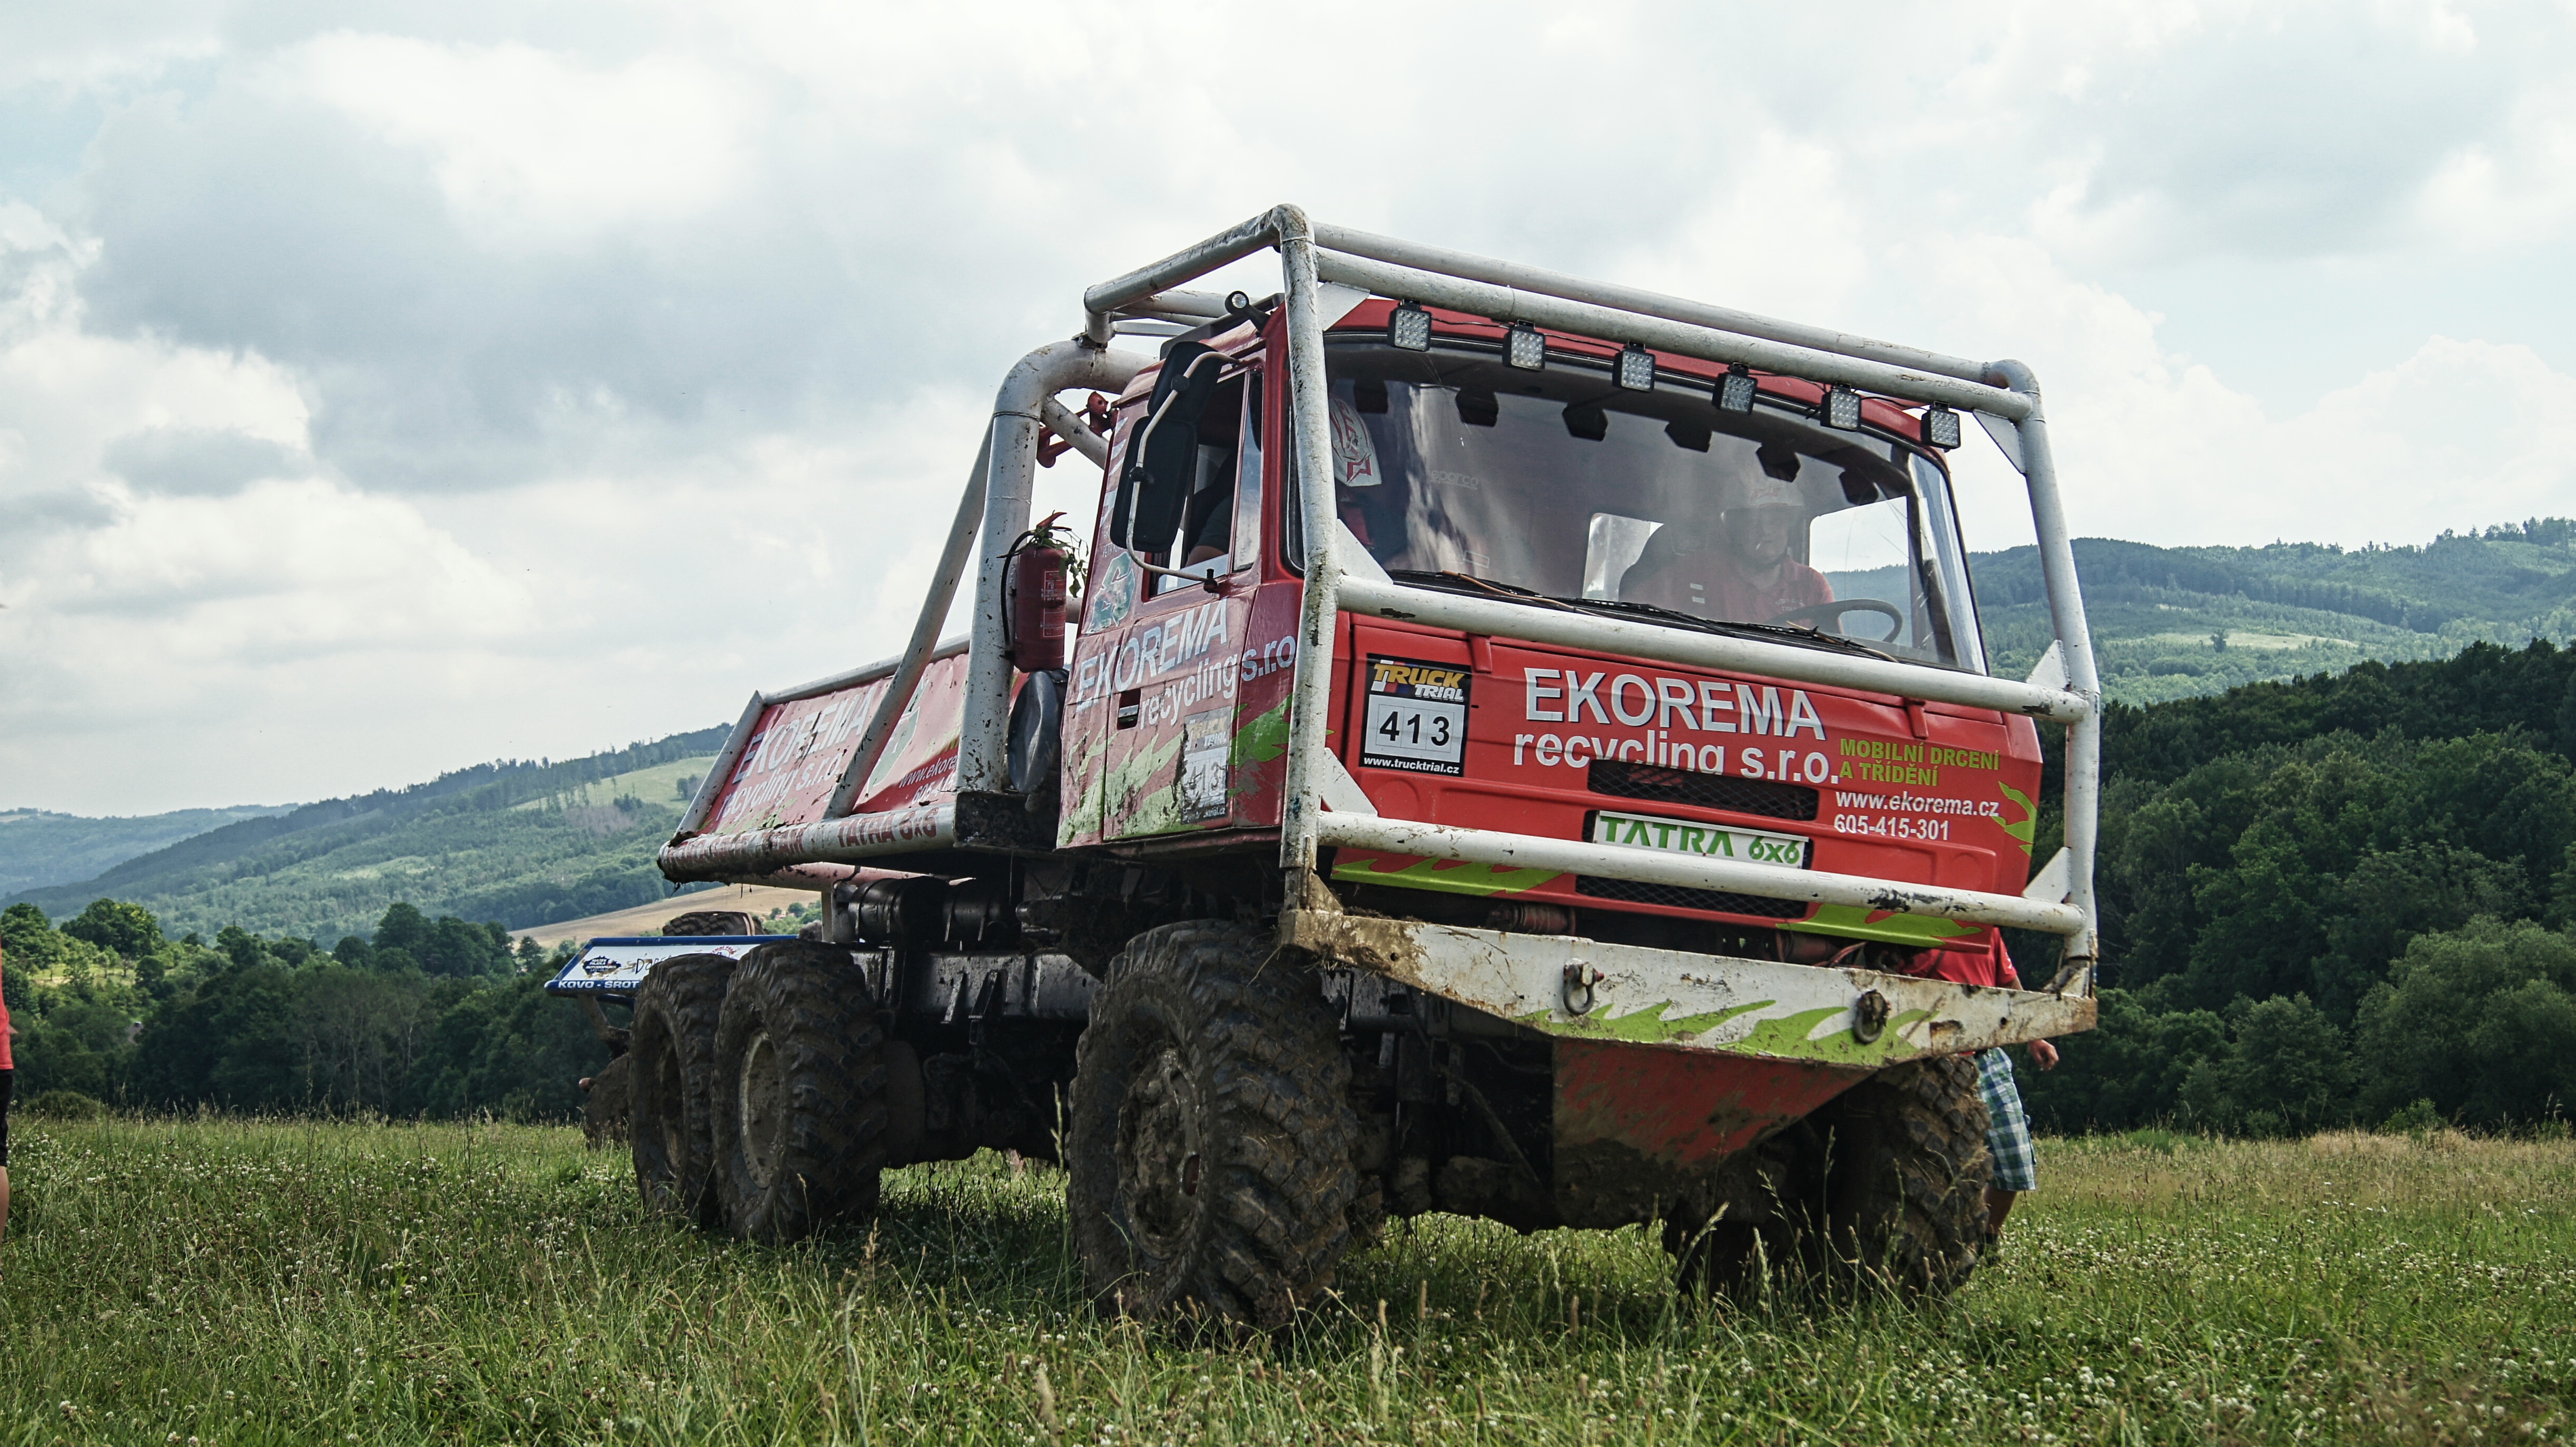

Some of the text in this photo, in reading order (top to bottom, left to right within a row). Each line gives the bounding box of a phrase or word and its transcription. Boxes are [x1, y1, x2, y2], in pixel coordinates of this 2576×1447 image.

[1077, 596, 1229, 712] EKOREMA
[1140, 654, 1238, 730] recycling
[1374, 664, 1465, 689] TRUCK
[1414, 684, 1465, 701] TRIAL
[1524, 667, 1826, 741] EKOREMA
[733, 685, 878, 784] EKOREMA
[1379, 711, 1450, 746] 413
[1364, 757, 1459, 774] www.trucktrial.cz
[1514, 730, 1840, 784] recycling s.r.o.
[1840, 738, 2000, 770] MOBILNÍ DRCENÍ
[1839, 761, 1938, 786] A TŘÍDĚNÍ
[715, 767, 799, 822] recycling
[1836, 791, 2000, 817] www.ekorema.cz
[899, 807, 939, 840] 6x6
[1600, 816, 1800, 865] TATRA 6x6
[1834, 814, 1949, 840] 605-415-301
